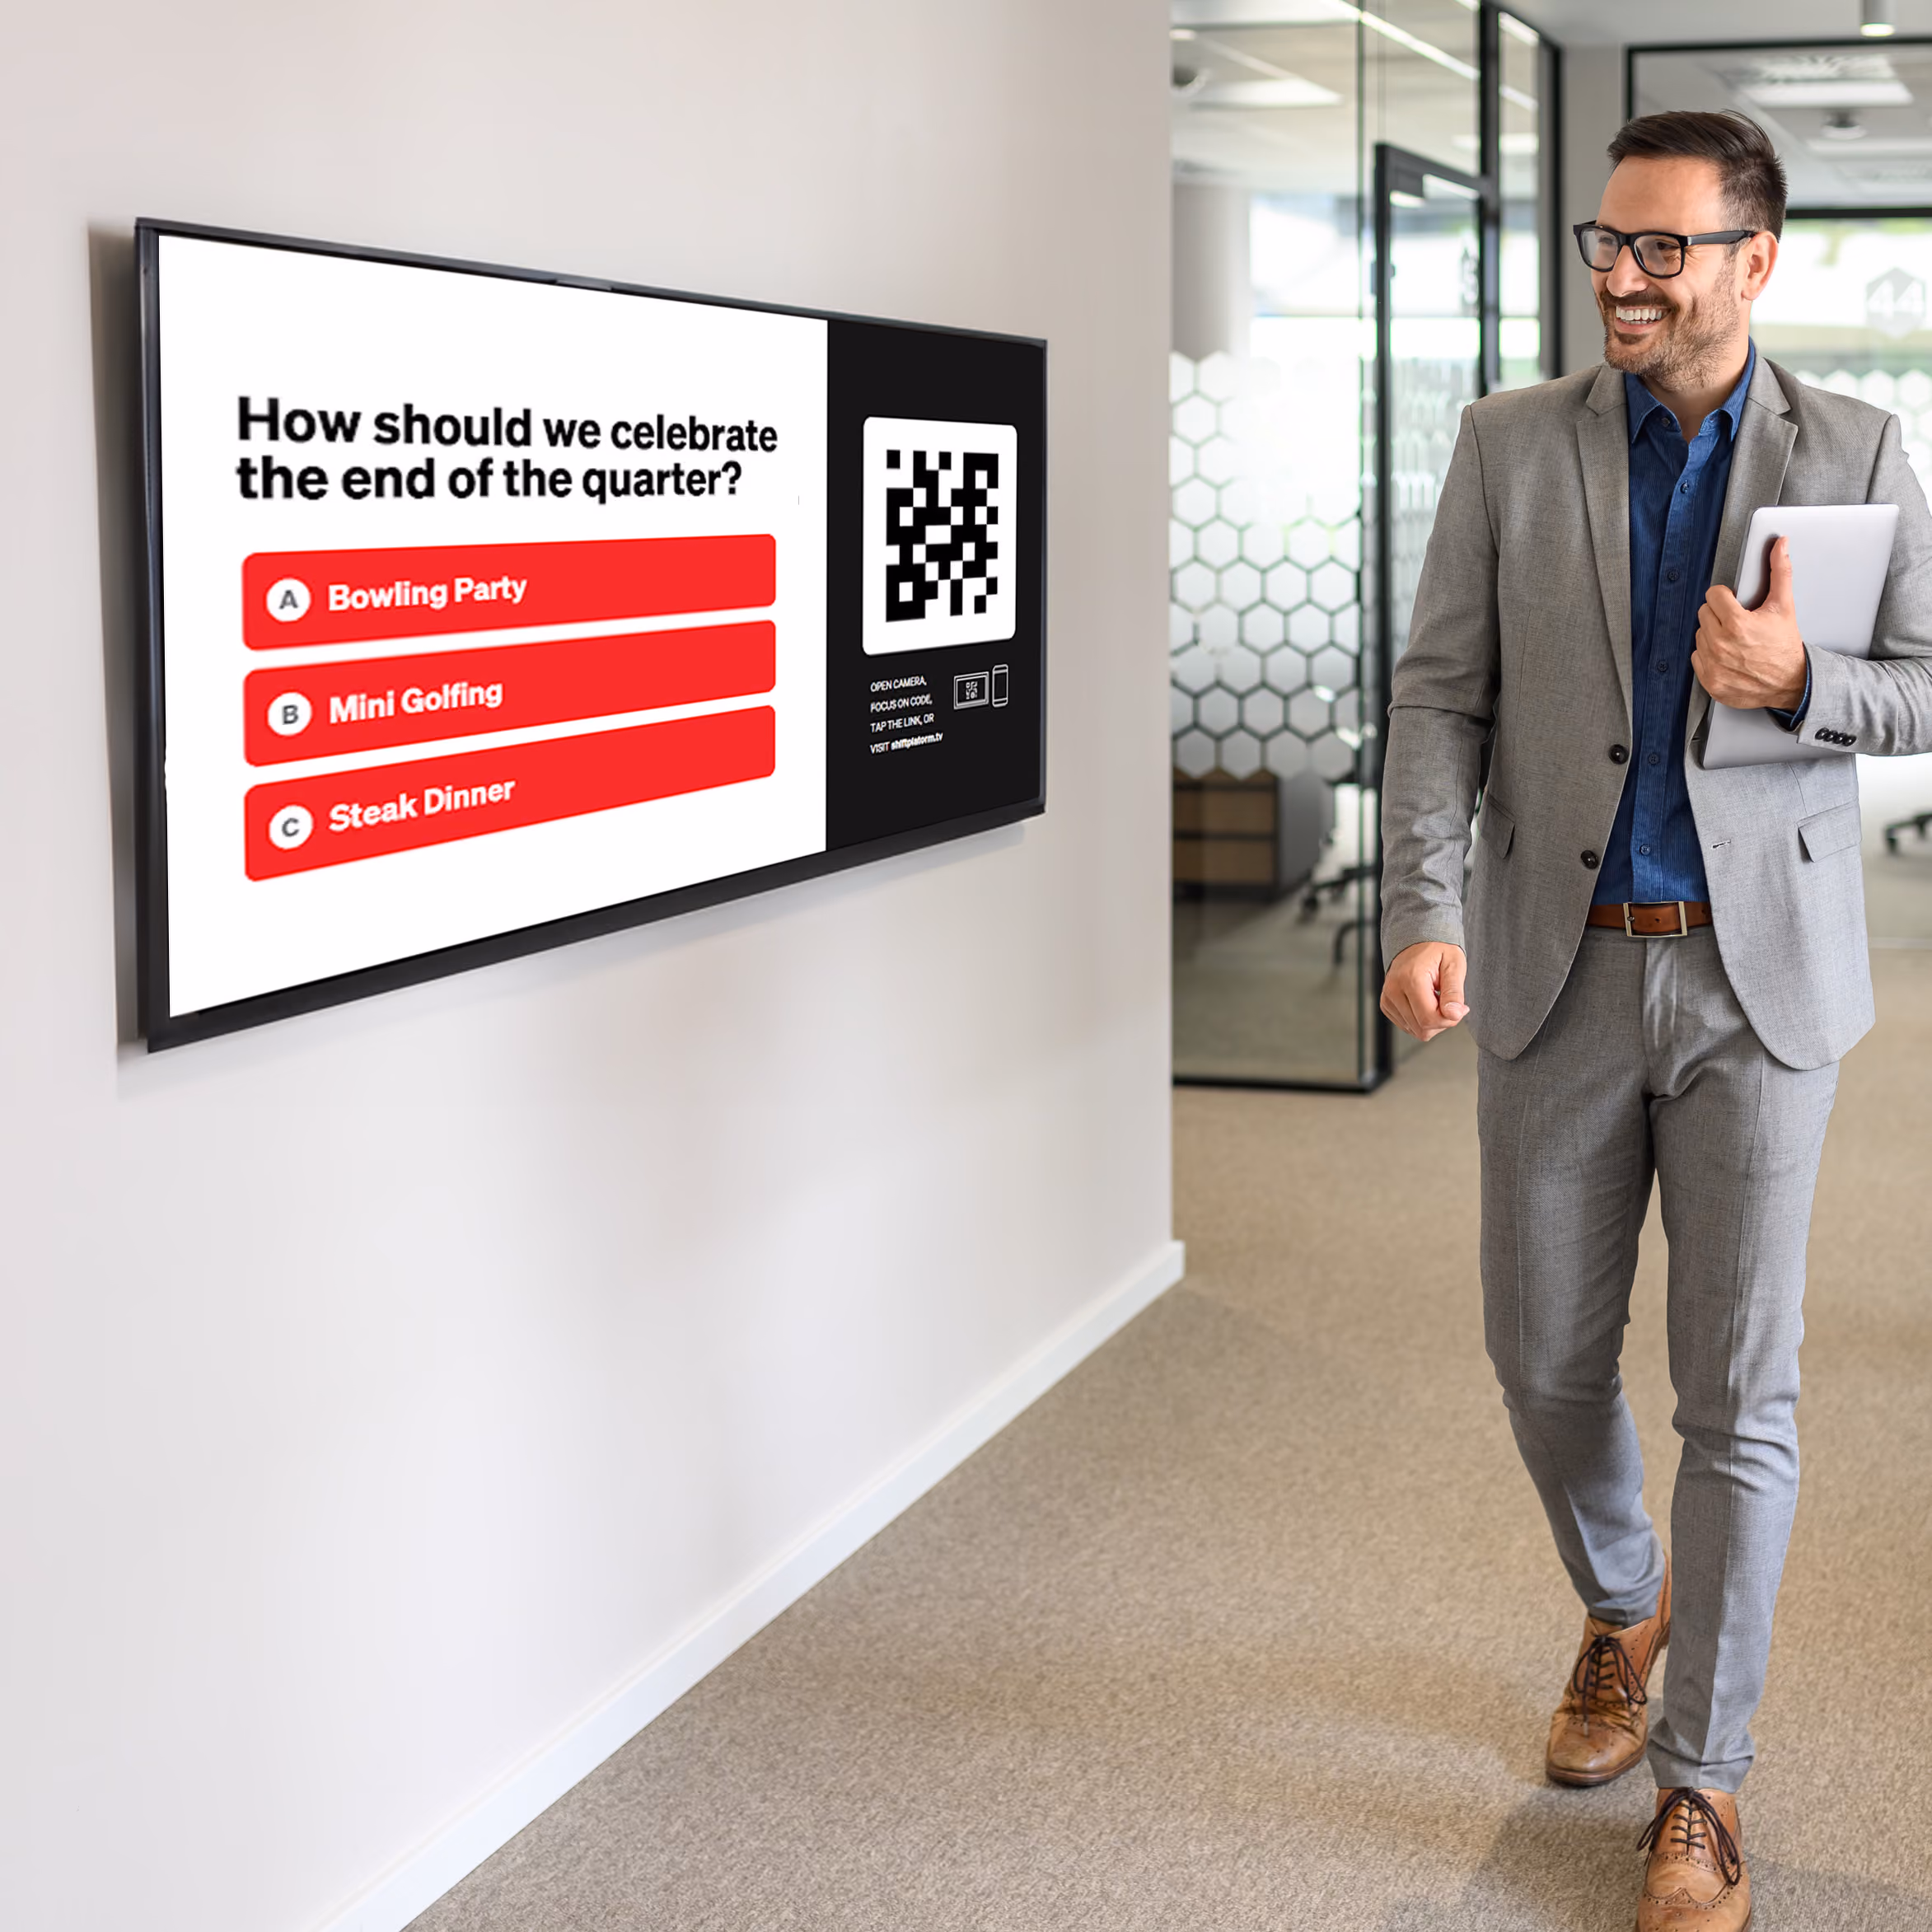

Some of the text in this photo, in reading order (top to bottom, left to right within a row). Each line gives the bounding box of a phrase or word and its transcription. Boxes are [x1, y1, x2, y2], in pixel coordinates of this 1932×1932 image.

[238, 395, 778, 453] How should we celebrate
[236, 456, 743, 504] the end of the quarter?
[279, 575, 528, 612] A Bowling Party
[870, 675, 927, 693] OPEN CAMERA,
[283, 681, 503, 726] B Mini Golfing
[870, 698, 897, 713] FOCUS
[897, 697, 910, 709] ON
[870, 721, 887, 733] TAP
[887, 718, 903, 730] THE
[923, 713, 935, 724] OR
[870, 741, 891, 755] VISIT
[281, 781, 516, 838] C Steak Dinner
